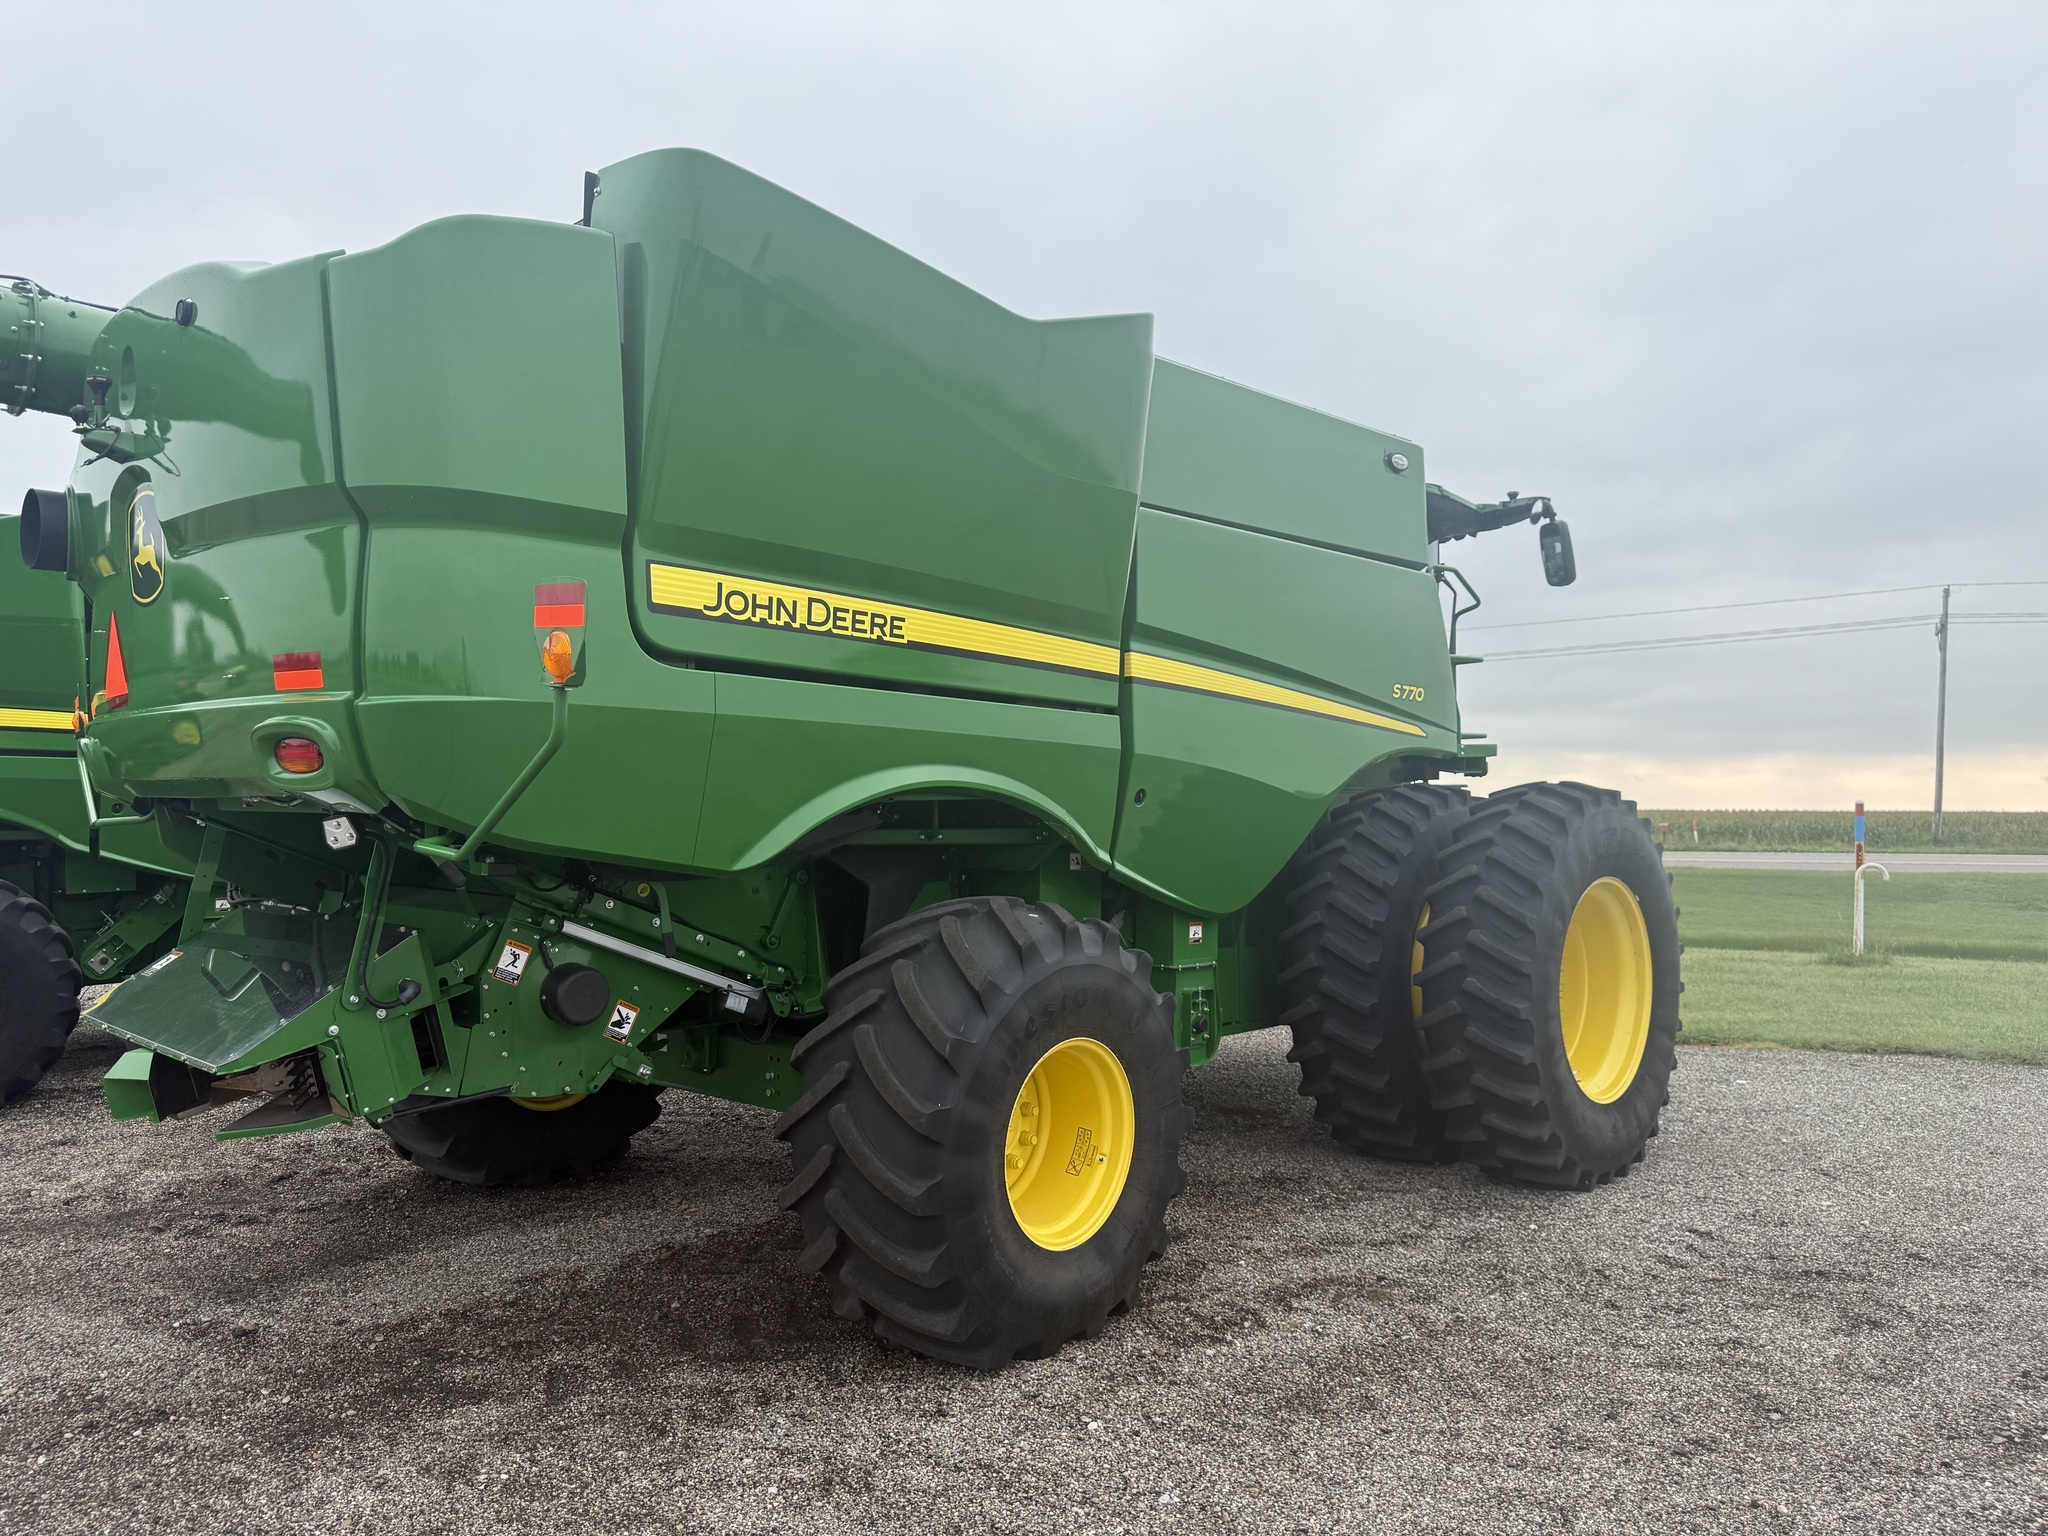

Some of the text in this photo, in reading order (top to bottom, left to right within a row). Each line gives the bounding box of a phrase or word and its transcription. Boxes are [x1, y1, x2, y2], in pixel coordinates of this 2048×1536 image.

[703, 581, 907, 640] JOHN DEERE
[1392, 683, 1425, 702] S770
